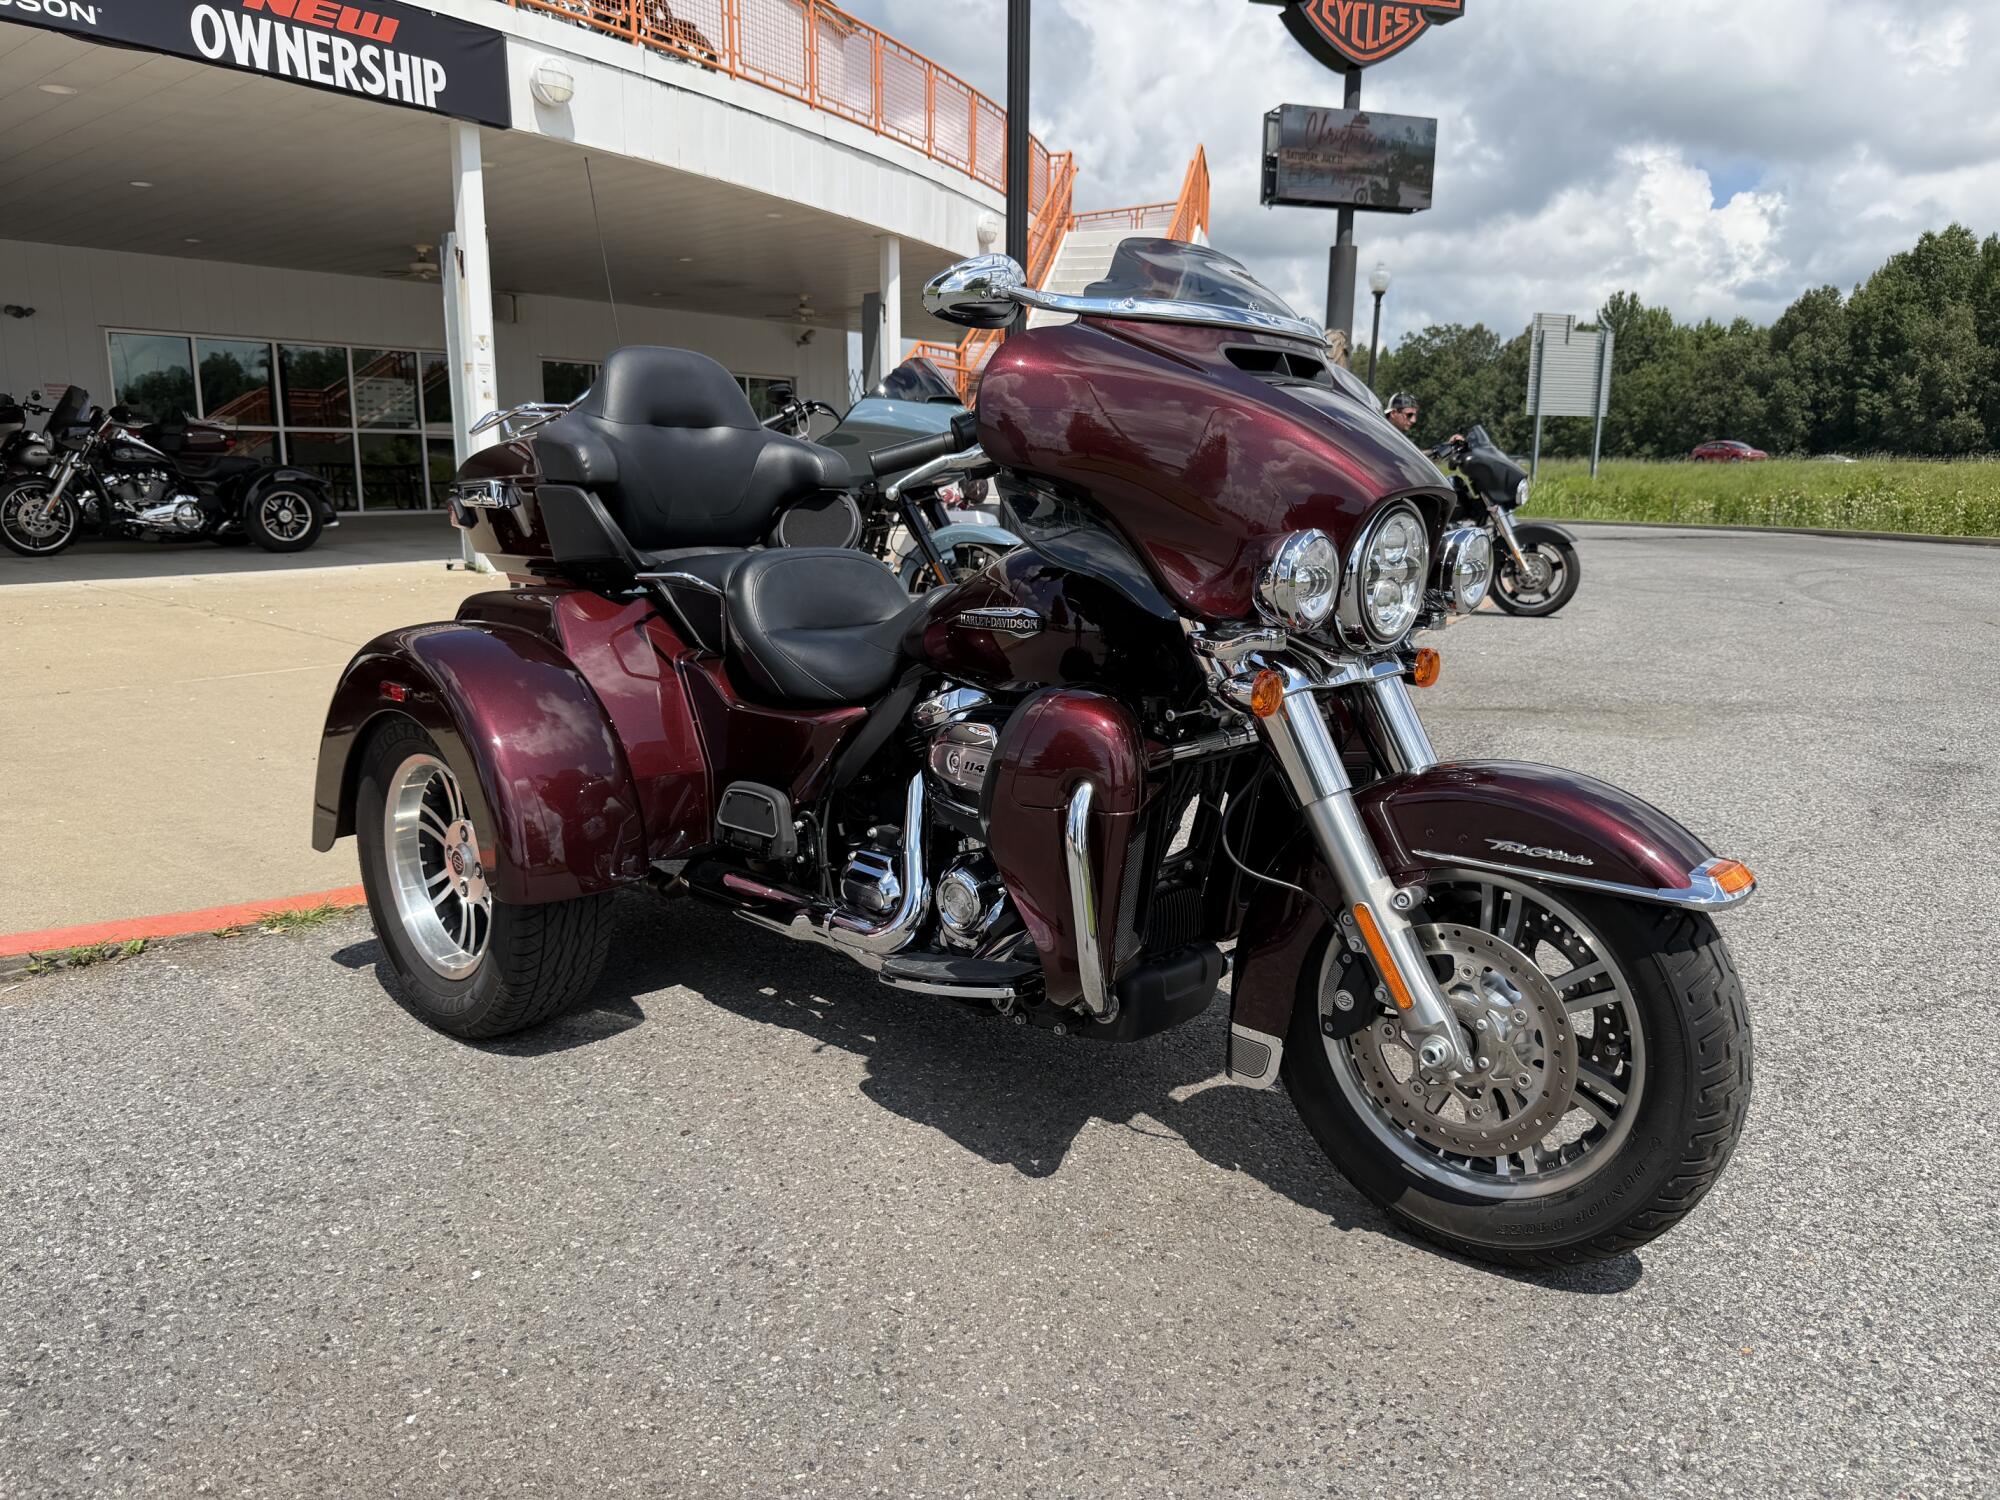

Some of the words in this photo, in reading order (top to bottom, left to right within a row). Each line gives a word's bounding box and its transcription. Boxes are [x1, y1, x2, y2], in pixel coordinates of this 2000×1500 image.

[242, 0, 400, 44] NEW
[1322, 0, 1410, 50] CYCLES
[190, 4, 447, 109] OWNERSHIP
[959, 613, 1038, 630] HARLEY-DAVIDSON
[963, 761, 986, 774] 114
